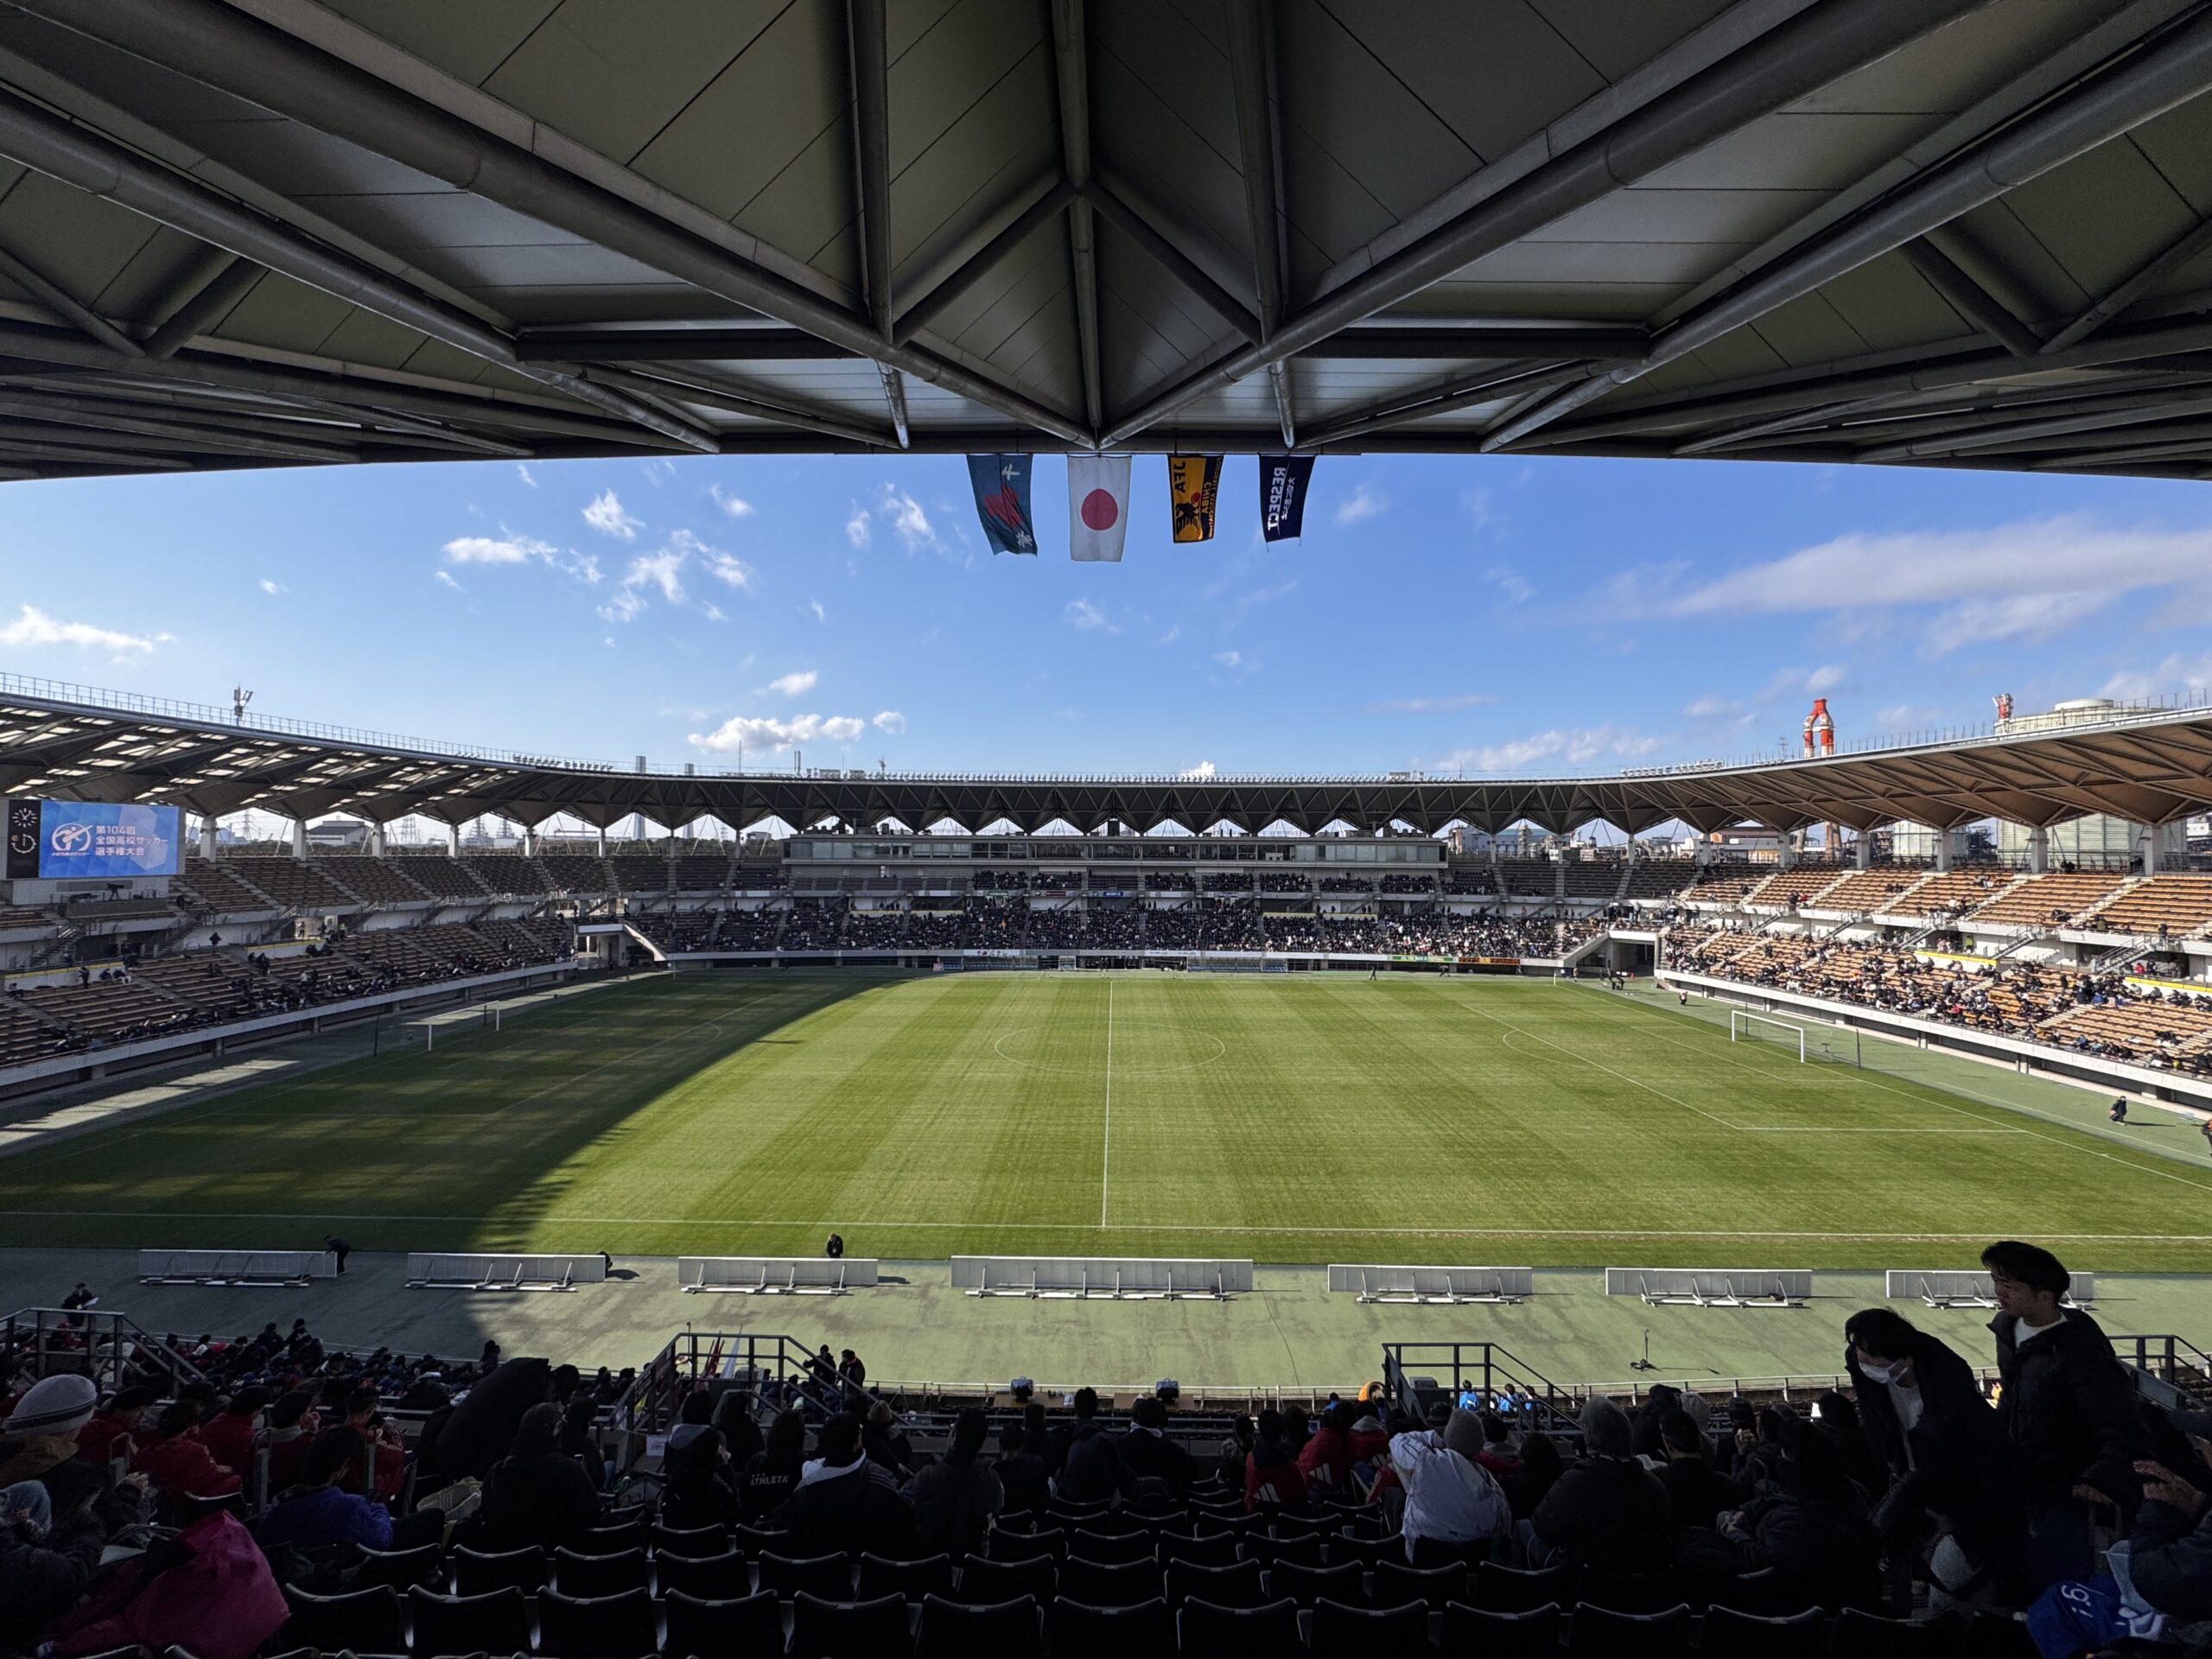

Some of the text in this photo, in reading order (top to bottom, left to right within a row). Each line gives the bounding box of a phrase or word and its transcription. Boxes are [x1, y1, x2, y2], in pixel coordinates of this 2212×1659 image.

[96, 825, 136, 835] 第104回
[95, 836, 168, 845] 全国高校サッカー
[95, 846, 145, 856] 選手権大会
[750, 1474, 788, 1486] ATHLETA
